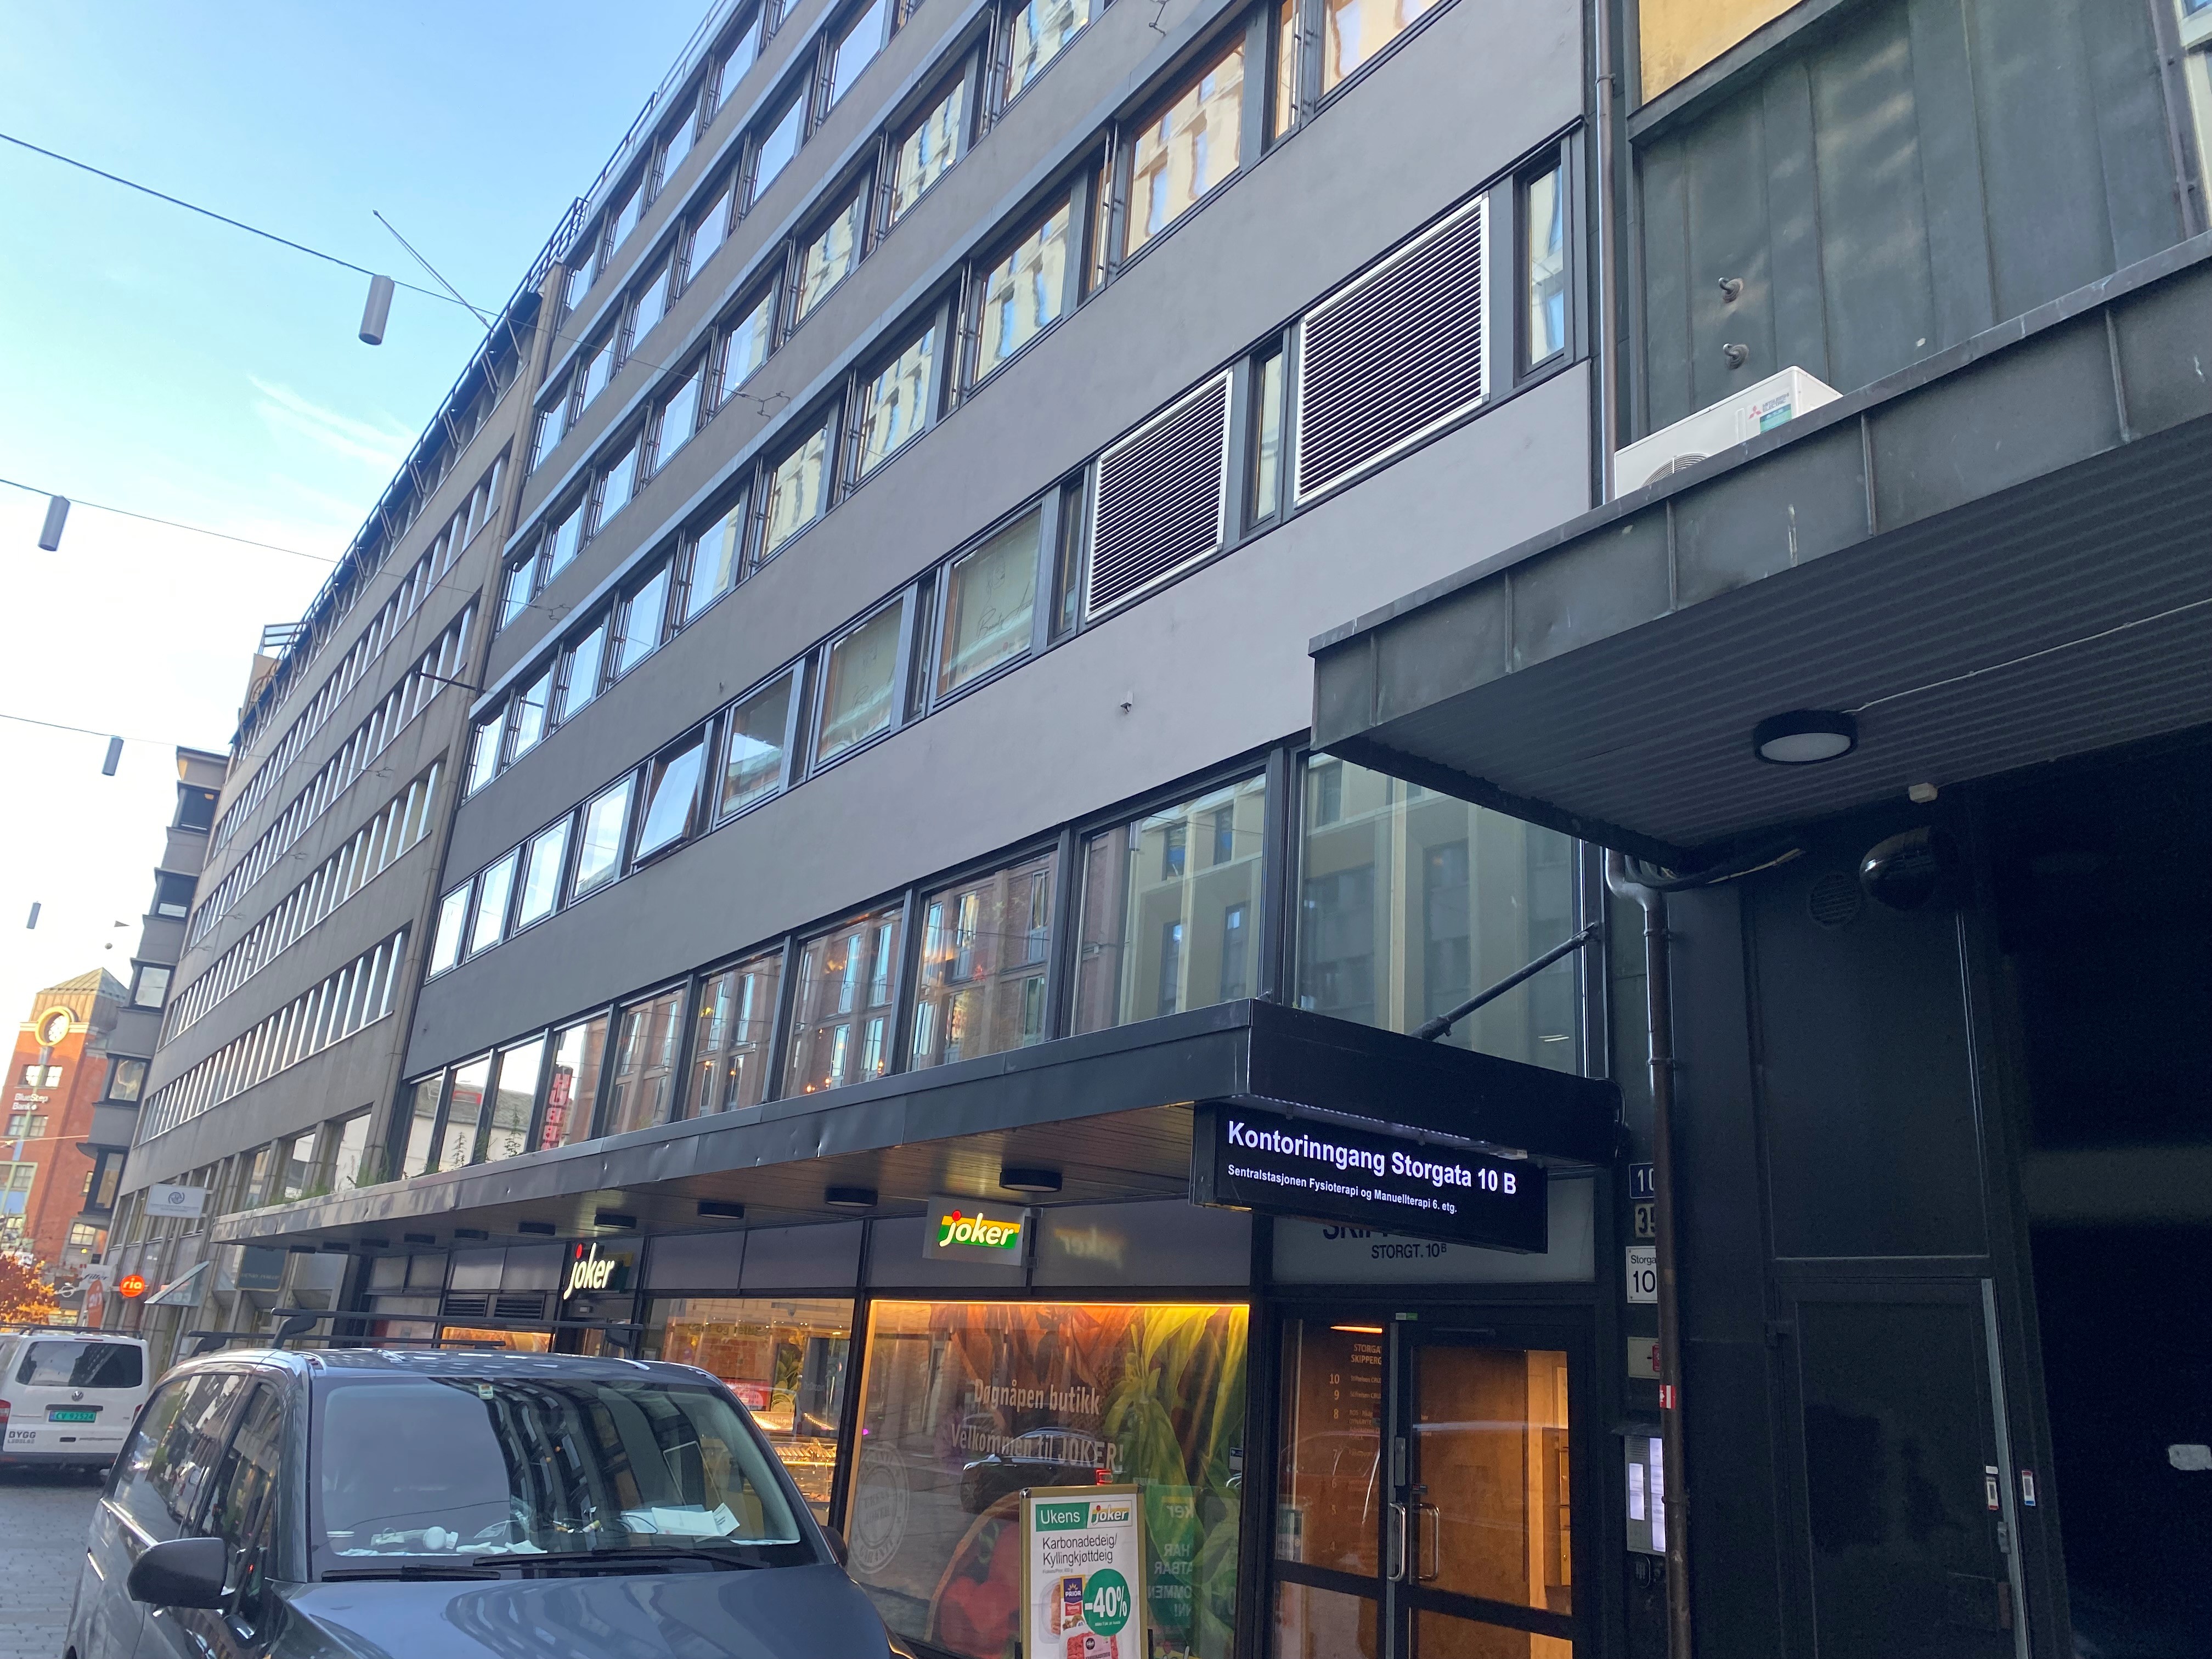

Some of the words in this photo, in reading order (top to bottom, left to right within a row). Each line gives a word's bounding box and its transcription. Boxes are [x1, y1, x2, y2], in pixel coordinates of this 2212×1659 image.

[1228, 1120, 1385, 1177] Kontorinngang
[1391, 1152, 1472, 1187] Storgata
[1477, 1168, 1498, 1192] 10
[1504, 1172, 1517, 1194] B
[1228, 1164, 1307, 1187] Sentralstasjonen
[1309, 1178, 1359, 1197] Fysioterapi
[1361, 1189, 1372, 1200] og
[1374, 1189, 1431, 1209] Manuellterapi
[1432, 1199, 1440, 1210] 6.
[1442, 1202, 1457, 1214] etg.
[939, 1209, 1015, 1247] joker
[1371, 1243, 1424, 1259] STORGT.
[563, 1242, 615, 1300] joker
[1633, 1269, 1656, 1293] 10
[1353, 1344, 1382, 1354] STORGA
[1329, 1373, 1340, 1385] 10
[974, 1379, 1044, 1413] Døgnåpen
[1049, 1384, 1101, 1415] butikk
[1334, 1389, 1340, 1400] 9
[55, 1412, 66, 1420] CV
[1333, 1408, 1339, 1419] 8
[951, 1423, 1032, 1458] Velkommen
[1038, 1434, 1053, 1460] til
[1057, 1435, 1124, 1470] JOKER!
[1331, 1478, 1337, 1488] 6
[1040, 1509, 1080, 1525] Ukens
[1092, 1504, 1128, 1526] joker
[1042, 1532, 1118, 1550] Karbonadedeig/
[1043, 1548, 1113, 1568] Kyllingkjøttdeig
[1084, 1585, 1127, 1618] -40%
